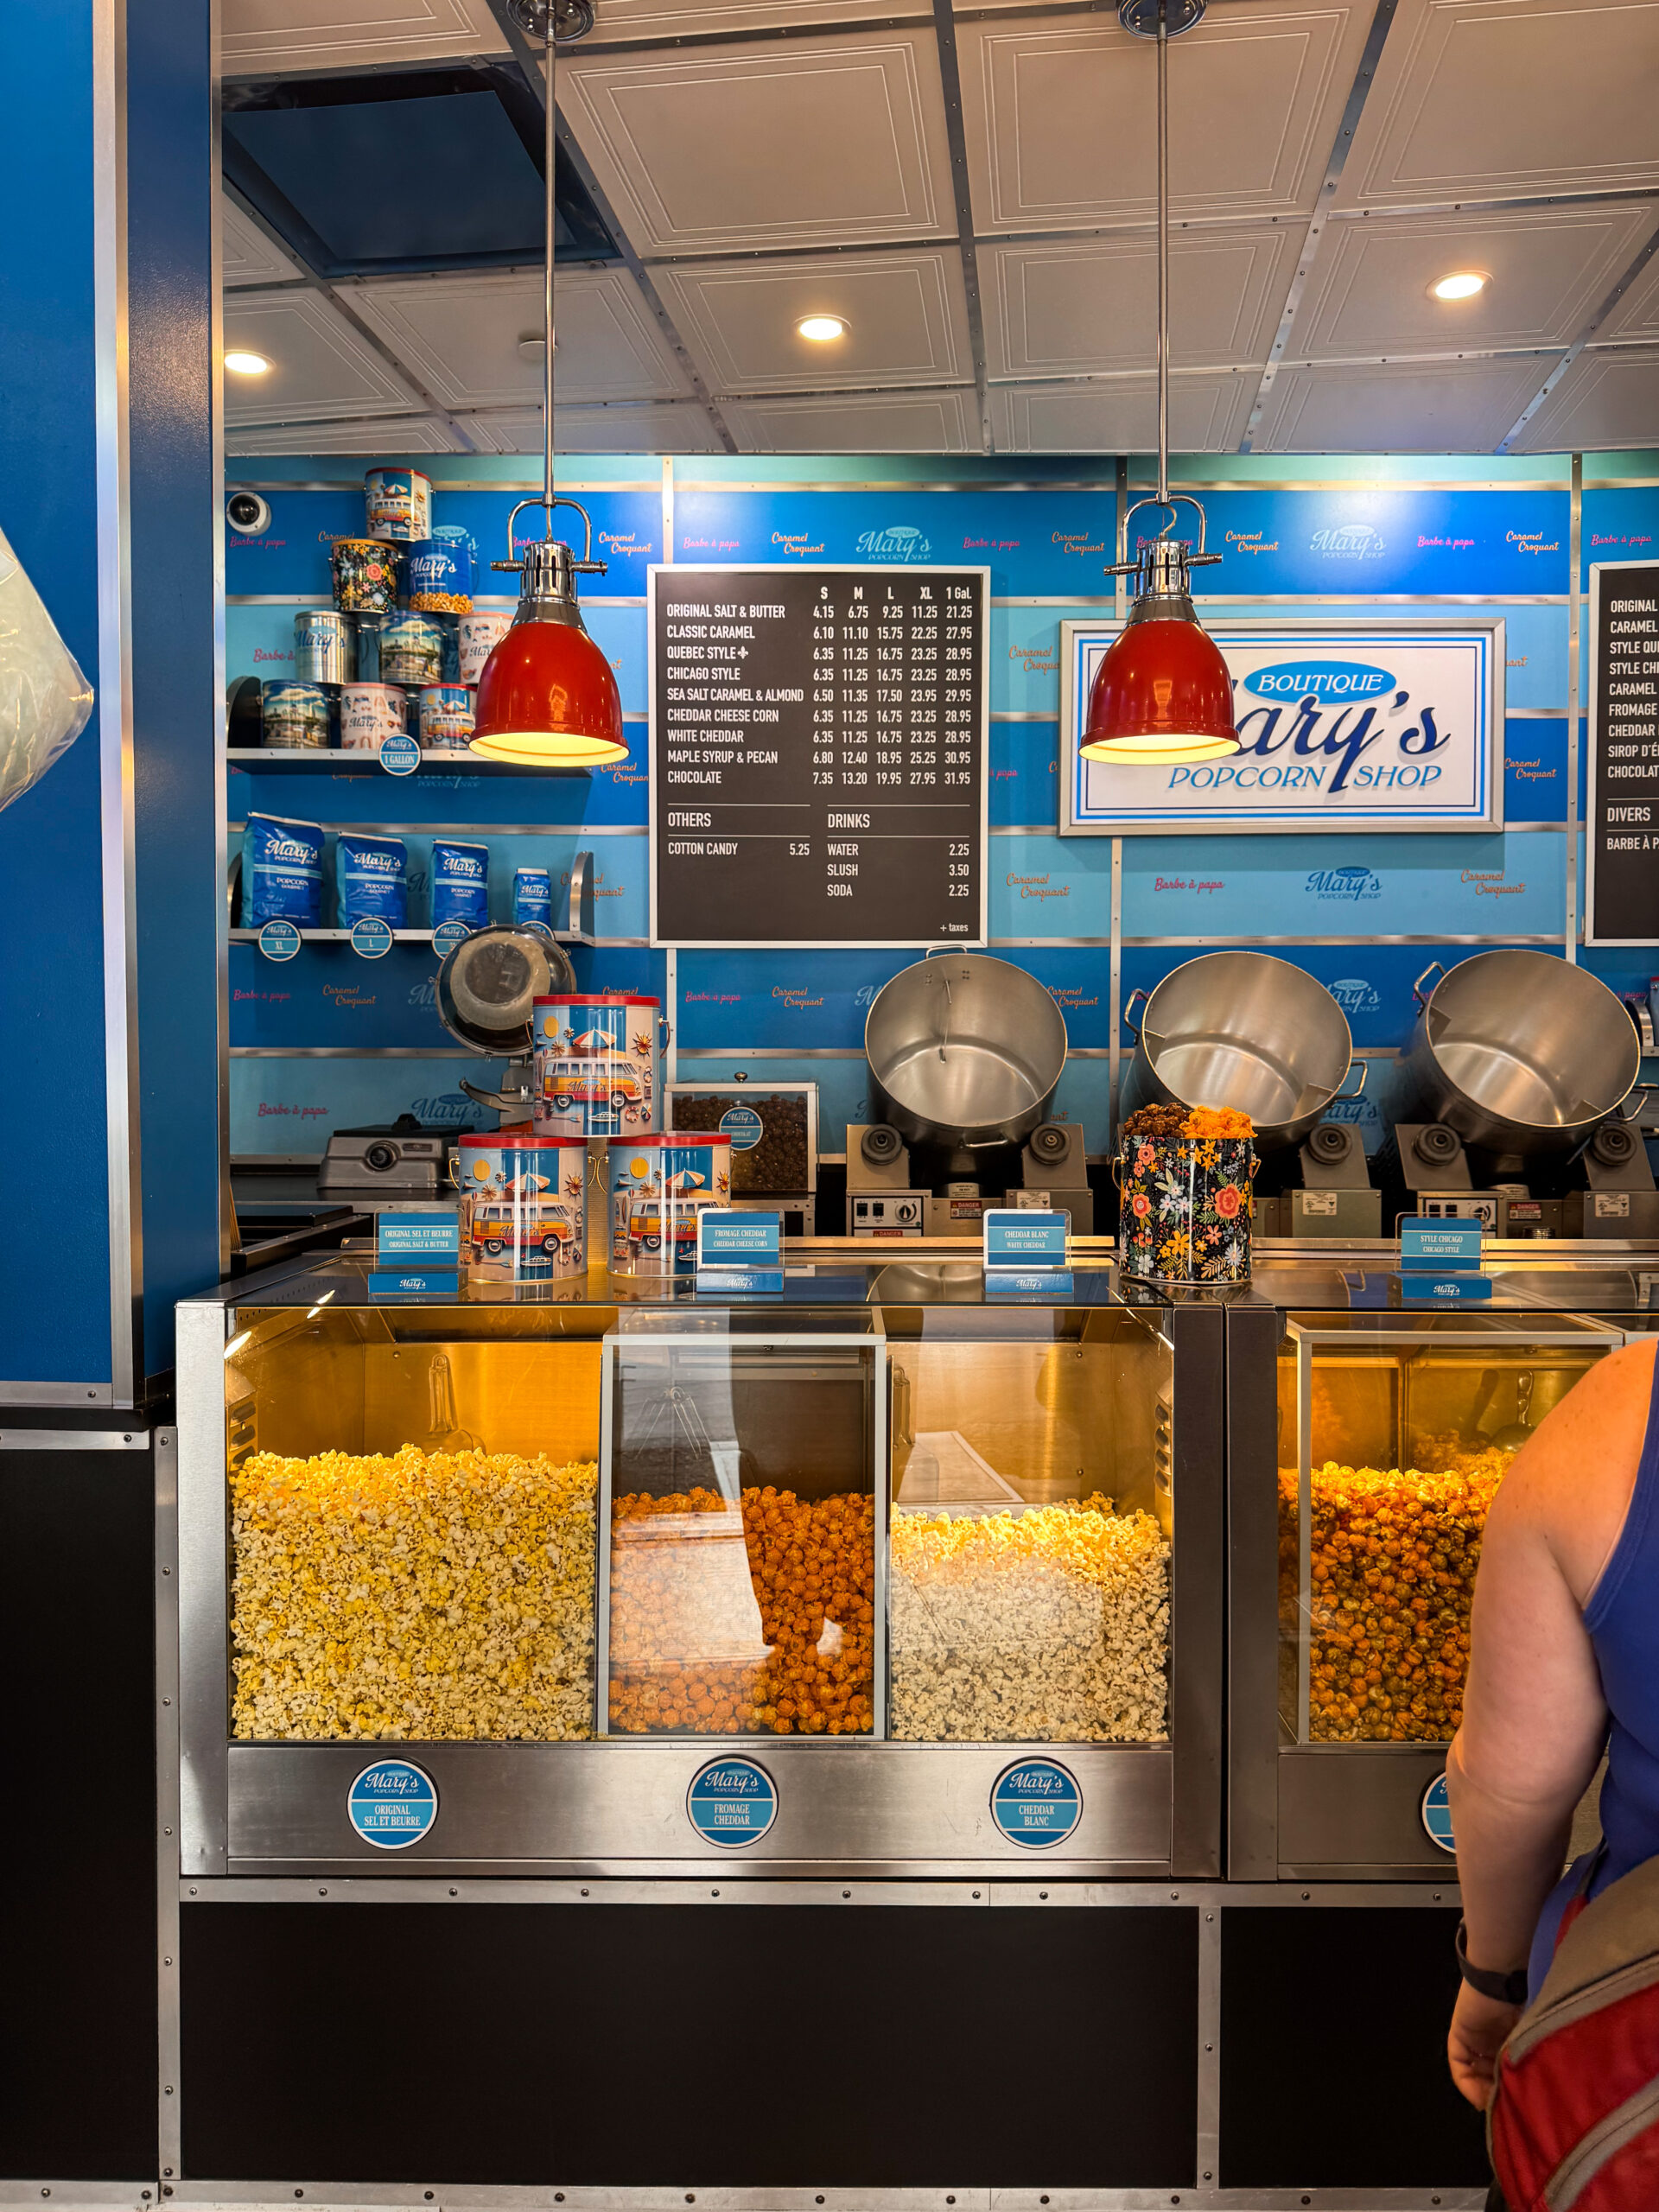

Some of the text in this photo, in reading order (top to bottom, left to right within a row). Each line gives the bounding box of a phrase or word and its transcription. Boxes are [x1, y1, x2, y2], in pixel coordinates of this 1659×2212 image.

[1417, 536, 1444, 547] Barbe
[1452, 538, 1475, 550] papa
[1505, 531, 1542, 543] Caramel
[855, 529, 932, 562] Mary's
[1518, 542, 1559, 555] Croquant
[410, 556, 457, 578] Mary's
[821, 587, 828, 600] S
[855, 587, 862, 600] M
[888, 587, 893, 600] L
[920, 587, 932, 599] XL
[946, 587, 951, 599] 1
[667, 605, 972, 618] ORIGINAL SALT & BUTTER 4.15 6.75 9.25 11.25 21.25
[1611, 600, 1658, 613] ORIGINAL
[667, 625, 972, 639] CLASSIC CARAMEL 6.10 11.10 15.75 22.25 27.95
[1610, 620, 1658, 633] CARAMEL
[667, 645, 971, 660] QUEBEC STYLE 6.35 11.25 16.75 23.25 28.95
[1610, 641, 1641, 654] STYLE
[667, 667, 741, 680] CHICAGO STYLE
[1609, 662, 1640, 675] STYLE
[1256, 674, 1383, 694] BOUTIQUE
[1609, 683, 1657, 696] CARAMEL
[667, 688, 971, 702] SEA SALT CARAMEL & ALMOND 6.50 11.35 17.50 23.95 29.95
[668, 709, 970, 722] CHEDDAR CHEESE CORN 6.35 11.25 16.75 23.25 28.95
[1609, 703, 1658, 716] FROMAGE
[667, 729, 744, 742] WHITE CHEDDAR
[1231, 679, 1452, 793] ary's
[1608, 724, 1656, 737] CHEDDAR
[668, 750, 970, 764] MAPLE SYRUP & PECAN 6.80 12.40 18.95 25.25 30.95
[1608, 745, 1639, 758] SIROP
[385, 755, 415, 764] 1 GALLON
[668, 771, 970, 785] CHOCOLATE 7.35 13.20 19.95 27.95 31.95
[1168, 766, 1442, 788] POPCORN SHOP
[668, 812, 711, 827] OTHERS
[828, 814, 870, 828] DRINKS
[1607, 807, 1651, 822] DIVERS
[669, 842, 810, 855] COTTON CANDY 5.25
[1607, 837, 1640, 849] BARBE
[1643, 835, 1649, 849] À
[264, 840, 318, 864] Mary's
[828, 843, 969, 855] WATER 2.25
[354, 853, 401, 872] Mary's
[828, 864, 969, 876] SLUSH 3.50
[276, 877, 308, 887] POPCORN
[1007, 872, 1050, 887] Caramel
[1154, 877, 1224, 894] Barbe à papa
[1305, 871, 1382, 900] Mary's
[827, 884, 969, 896] SODA 2.25
[1021, 885, 1071, 902] Croquant
[949, 923, 968, 931] taxes
[275, 941, 283, 950] XL
[369, 938, 373, 948] L
[365, 1772, 419, 1795] Mary's
[705, 1771, 760, 1794] Mary's
[1009, 1772, 1064, 1795] Mary's
[375, 1805, 410, 1815] ORIGINAL
[715, 1804, 750, 1814] FROMAGE
[1019, 1805, 1055, 1815] CHEDDAR
[364, 1816, 421, 1826] SEL ET BEURRE
[715, 1815, 750, 1825] CHEDDAR
[1024, 1816, 1049, 1826] BLANC
